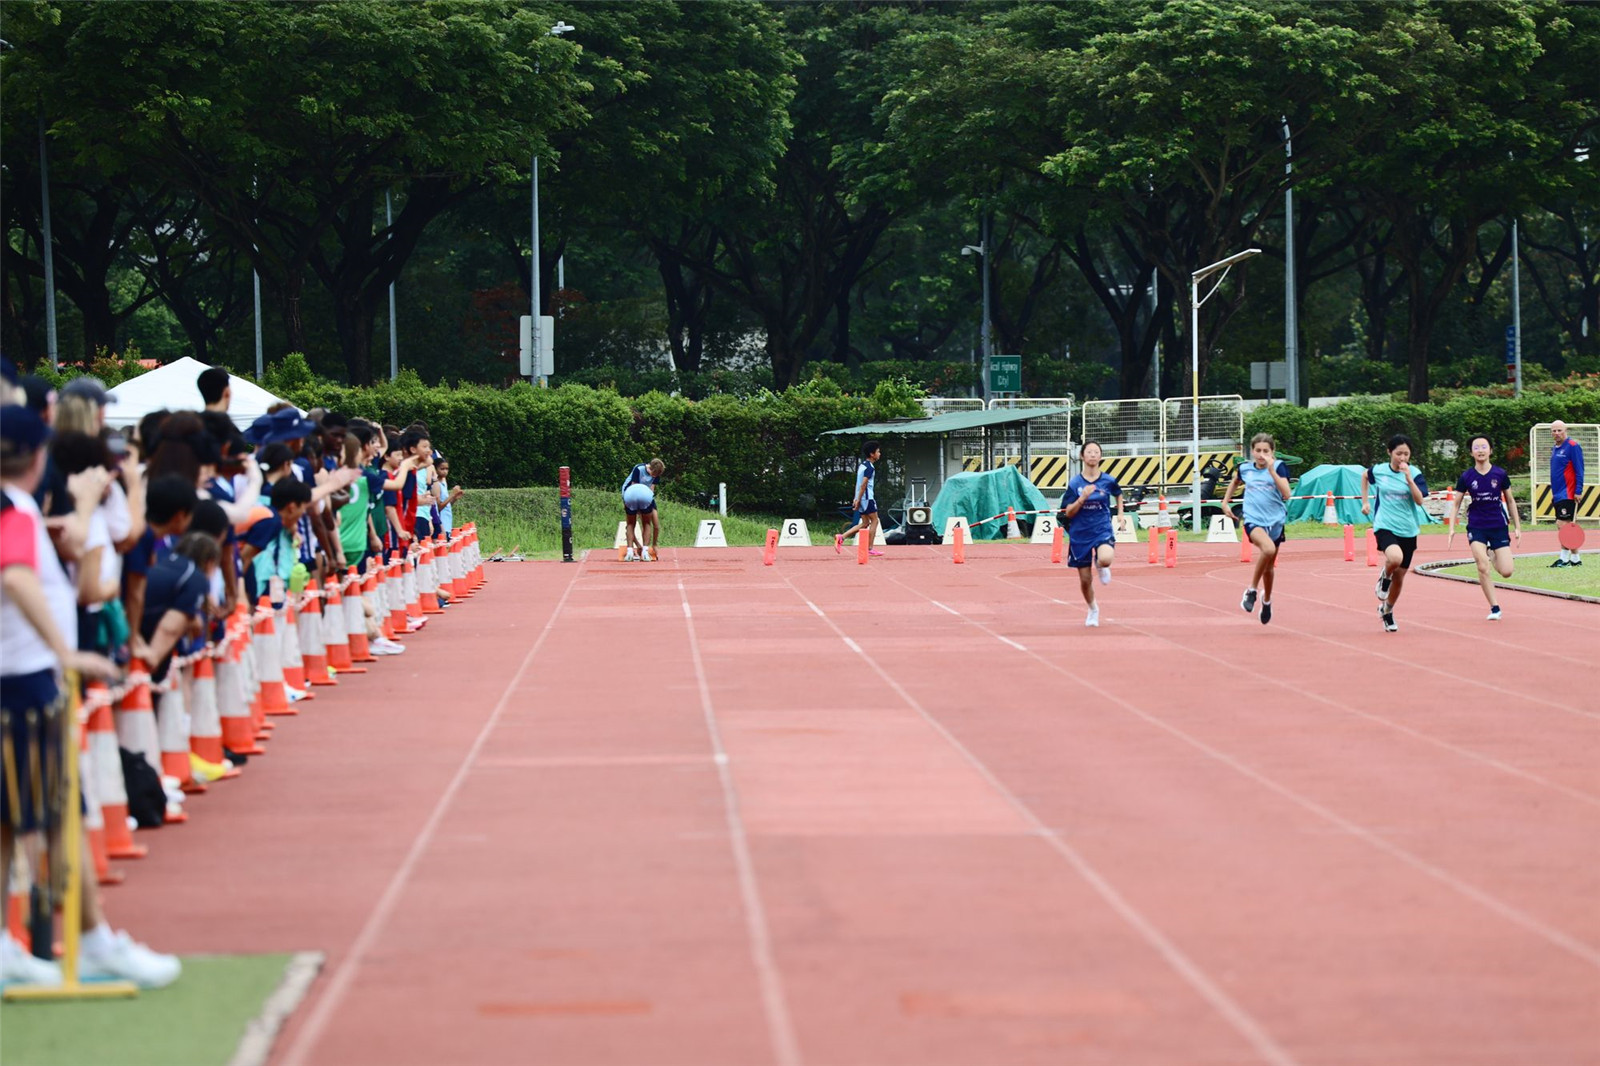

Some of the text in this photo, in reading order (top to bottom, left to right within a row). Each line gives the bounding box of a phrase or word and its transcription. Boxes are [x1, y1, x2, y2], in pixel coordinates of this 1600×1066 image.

[707, 522, 716, 535] 7
[788, 522, 797, 535] 6
[1042, 520, 1051, 533] 3
[1218, 517, 1224, 531] 1
